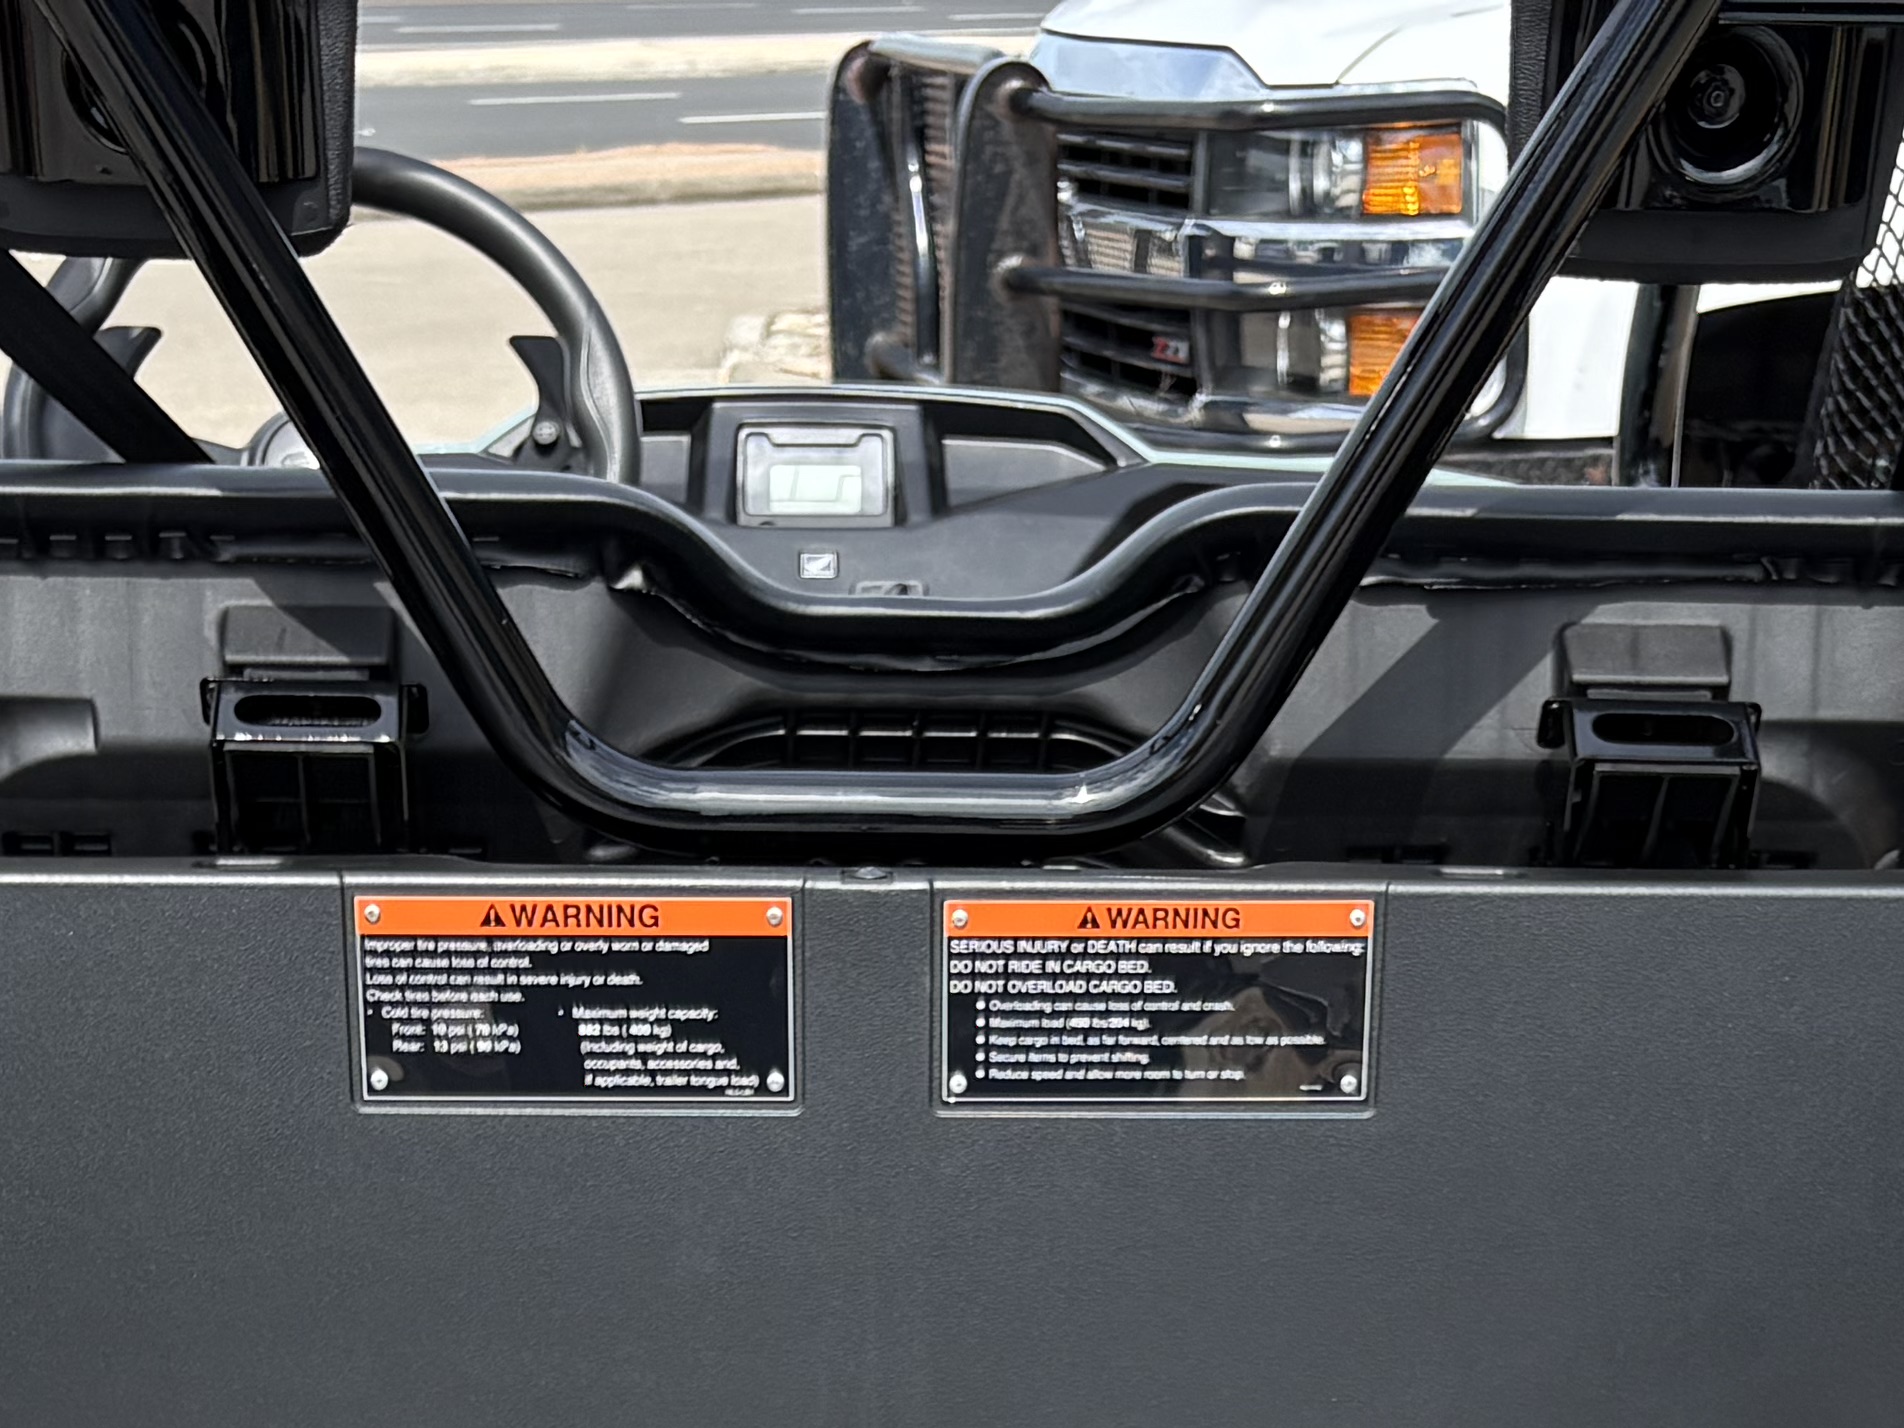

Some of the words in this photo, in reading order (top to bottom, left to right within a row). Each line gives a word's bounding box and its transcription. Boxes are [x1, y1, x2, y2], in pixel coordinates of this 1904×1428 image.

[509, 904, 660, 928] WARNING
[1106, 907, 1241, 930] WARNING
[365, 939, 415, 953] Improper
[417, 939, 436, 951] tire
[437, 940, 492, 953] pressure,
[493, 939, 558, 954] overloading
[560, 941, 573, 951] or
[574, 939, 610, 954] overly
[611, 941, 640, 951] worn
[641, 941, 654, 951] or
[655, 939, 710, 954] damaged
[950, 940, 1015, 954] SERIOUS
[1016, 940, 1069, 954] INJURY
[1070, 942, 1086, 954] or
[1087, 940, 1137, 954] DEATH
[1138, 942, 1162, 954] can
[1165, 940, 1201, 954] result
[1203, 940, 1212, 954] if
[1214, 942, 1239, 956] you
[1240, 940, 1281, 956] ignore
[1283, 940, 1304, 954] the
[1306, 940, 1365, 956] following:
[365, 956, 390, 968] tires
[392, 957, 413, 968] can
[415, 957, 449, 968] cause
[451, 956, 475, 968] loss
[477, 956, 489, 968] of
[490, 956, 532, 968] control.
[950, 960, 972, 974] DO
[975, 960, 1006, 974] NOT
[1008, 960, 1043, 974] RIDE
[1045, 960, 1061, 974] IN
[1063, 960, 1116, 974] CARGO
[1118, 960, 1152, 974] BED.
[365, 972, 393, 985] Loss
[395, 972, 407, 985] of
[409, 972, 447, 985] control
[449, 974, 471, 985] can
[473, 972, 505, 985] result
[506, 972, 518, 985] in
[519, 974, 558, 985] severe
[560, 973, 591, 988] injury
[592, 974, 605, 985] or
[607, 972, 643, 985] death.
[950, 980, 972, 994] DO
[975, 980, 1006, 994] NOT
[1007, 980, 1087, 994] OVERLOAD
[1088, 980, 1142, 994] CARGO
[1144, 980, 1178, 994] BED.
[366, 989, 403, 1002] Check
[404, 989, 430, 1002] tires
[431, 989, 468, 1002] before
[470, 989, 498, 1002] each
[500, 991, 525, 1002] use.
